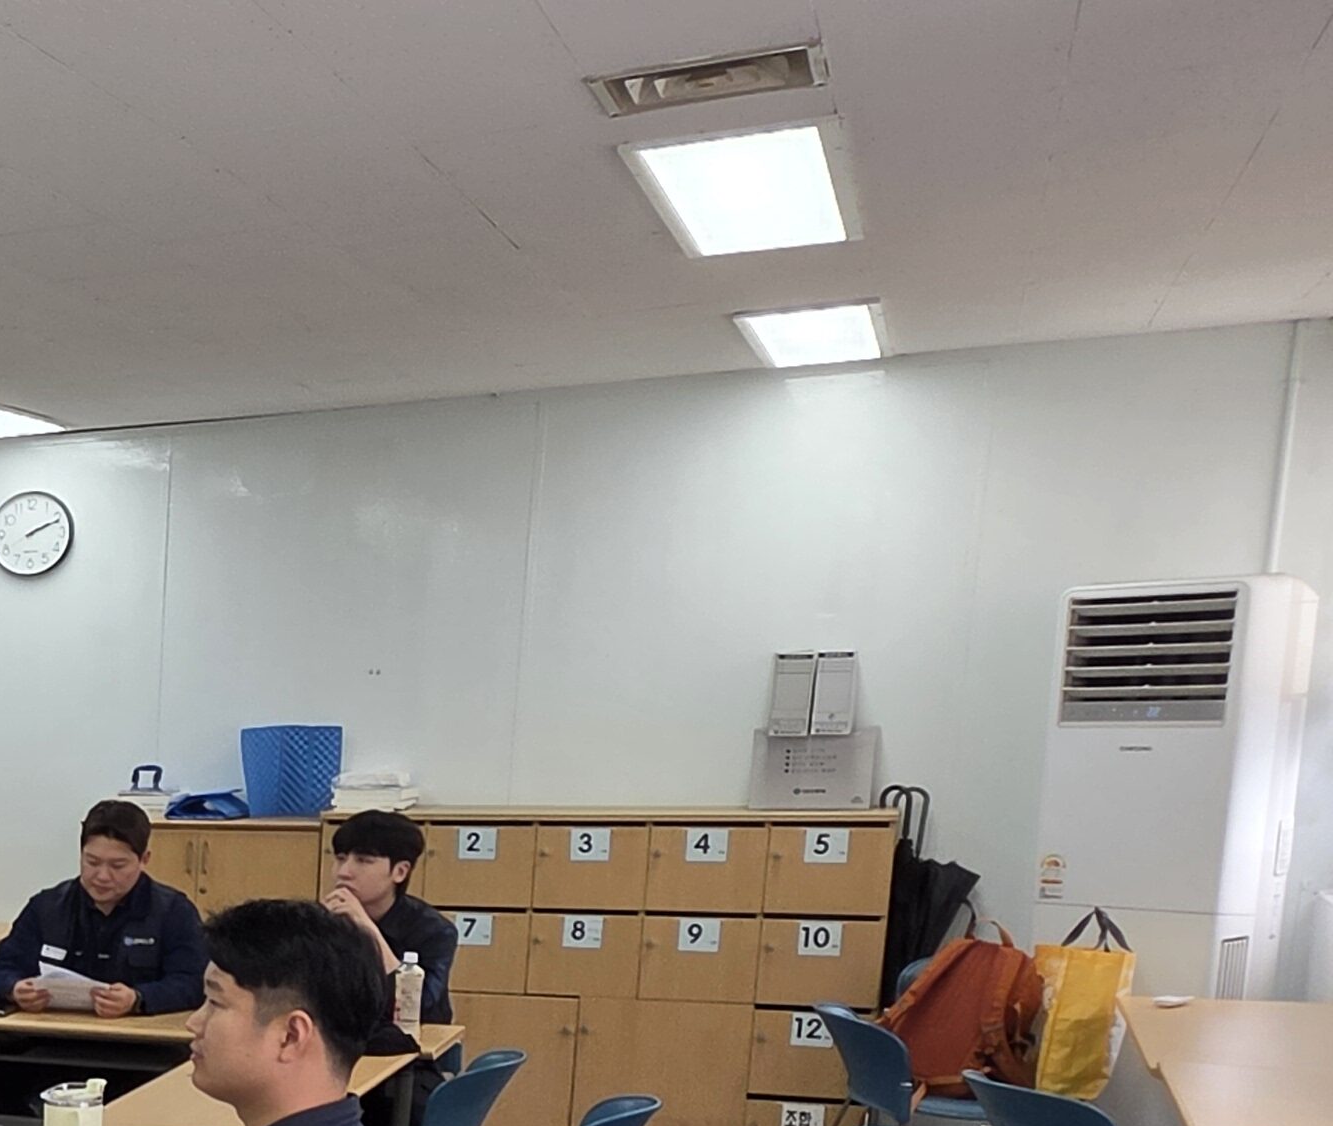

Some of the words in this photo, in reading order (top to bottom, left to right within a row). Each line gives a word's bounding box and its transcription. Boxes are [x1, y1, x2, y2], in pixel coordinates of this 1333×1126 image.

[15, 503, 23, 514] 11
[27, 498, 37, 511] 12
[4, 514, 16, 526] 10
[2, 544, 10, 556] 8
[52, 541, 60, 552] 4
[13, 553, 21, 565] 7
[26, 558, 34, 569] 6
[41, 553, 50, 564] 5
[466, 832, 480, 852] 2
[578, 833, 593, 853] 3
[693, 833, 710, 854] 4
[814, 833, 830, 855] 5
[463, 917, 477, 938] 7
[571, 920, 585, 941] 8
[687, 923, 703, 944] 9
[802, 926, 830, 948] 10
[795, 1017, 822, 1040] 12
